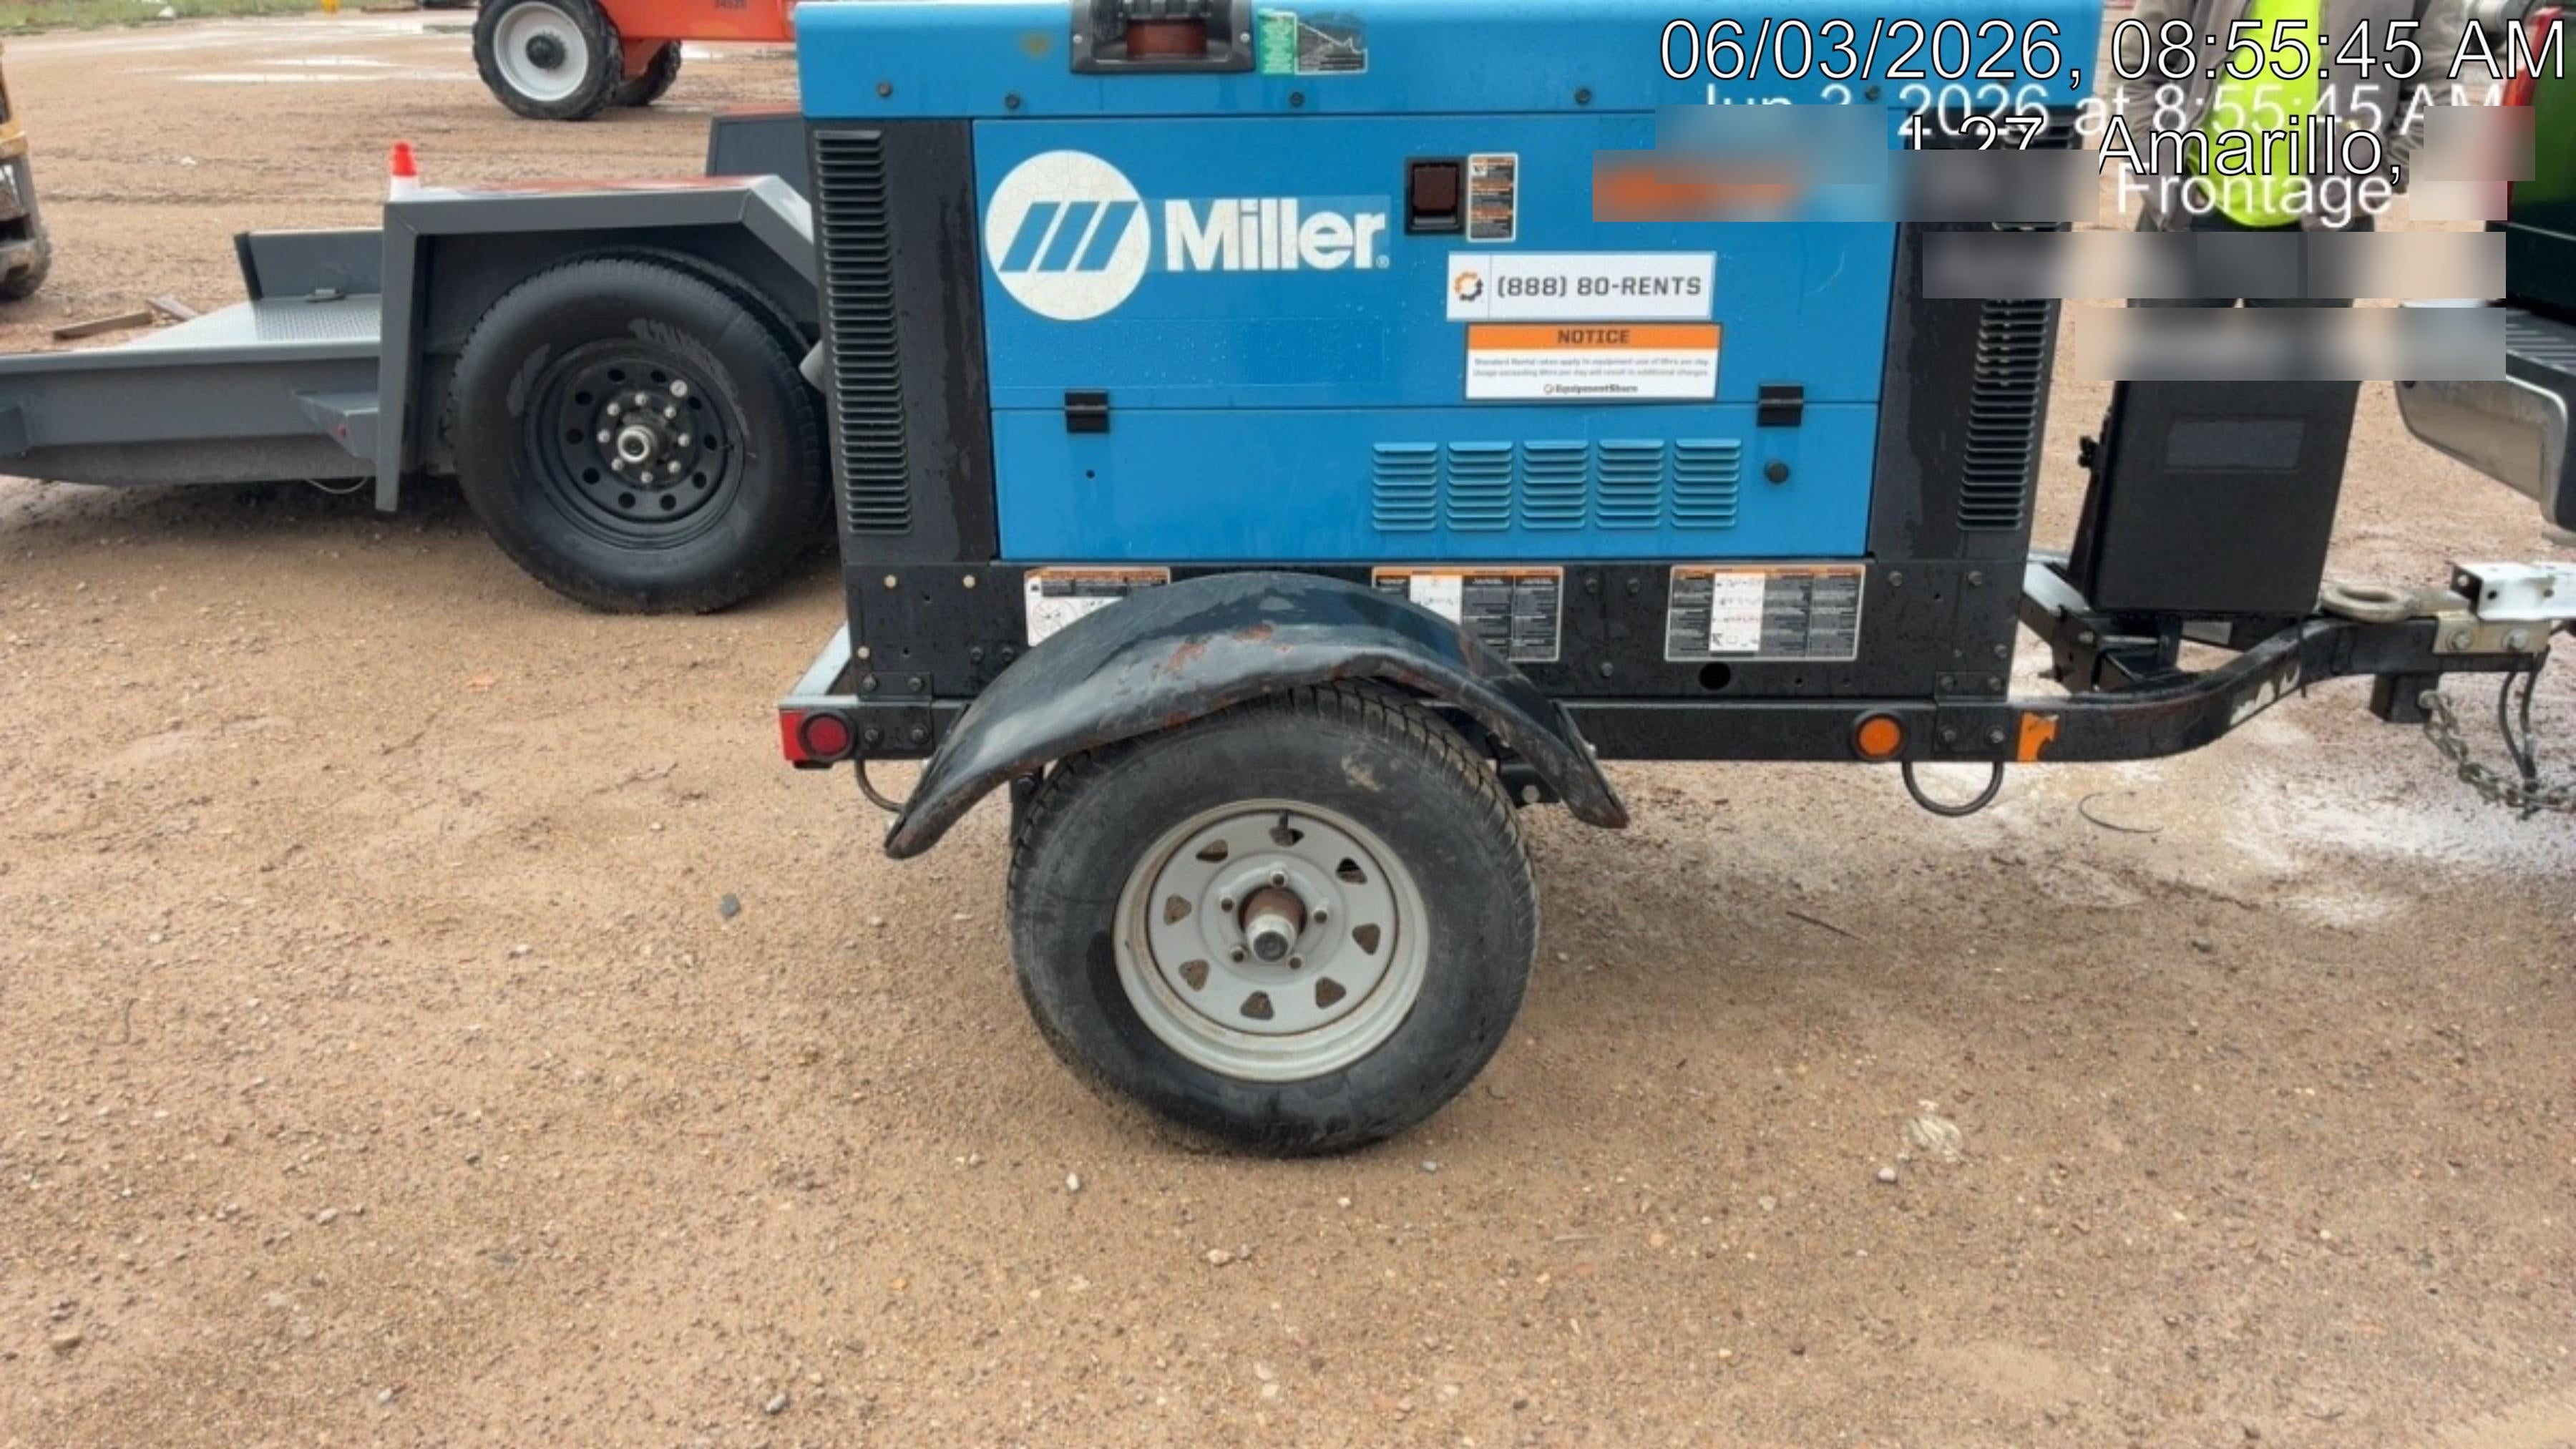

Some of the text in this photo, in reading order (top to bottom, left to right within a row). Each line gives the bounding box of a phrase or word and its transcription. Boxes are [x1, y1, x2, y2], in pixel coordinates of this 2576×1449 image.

[1165, 197, 1386, 271] Miller
[1498, 275, 1702, 298] (888) 80-RENTS
[1558, 330, 1631, 344] NOTICE
